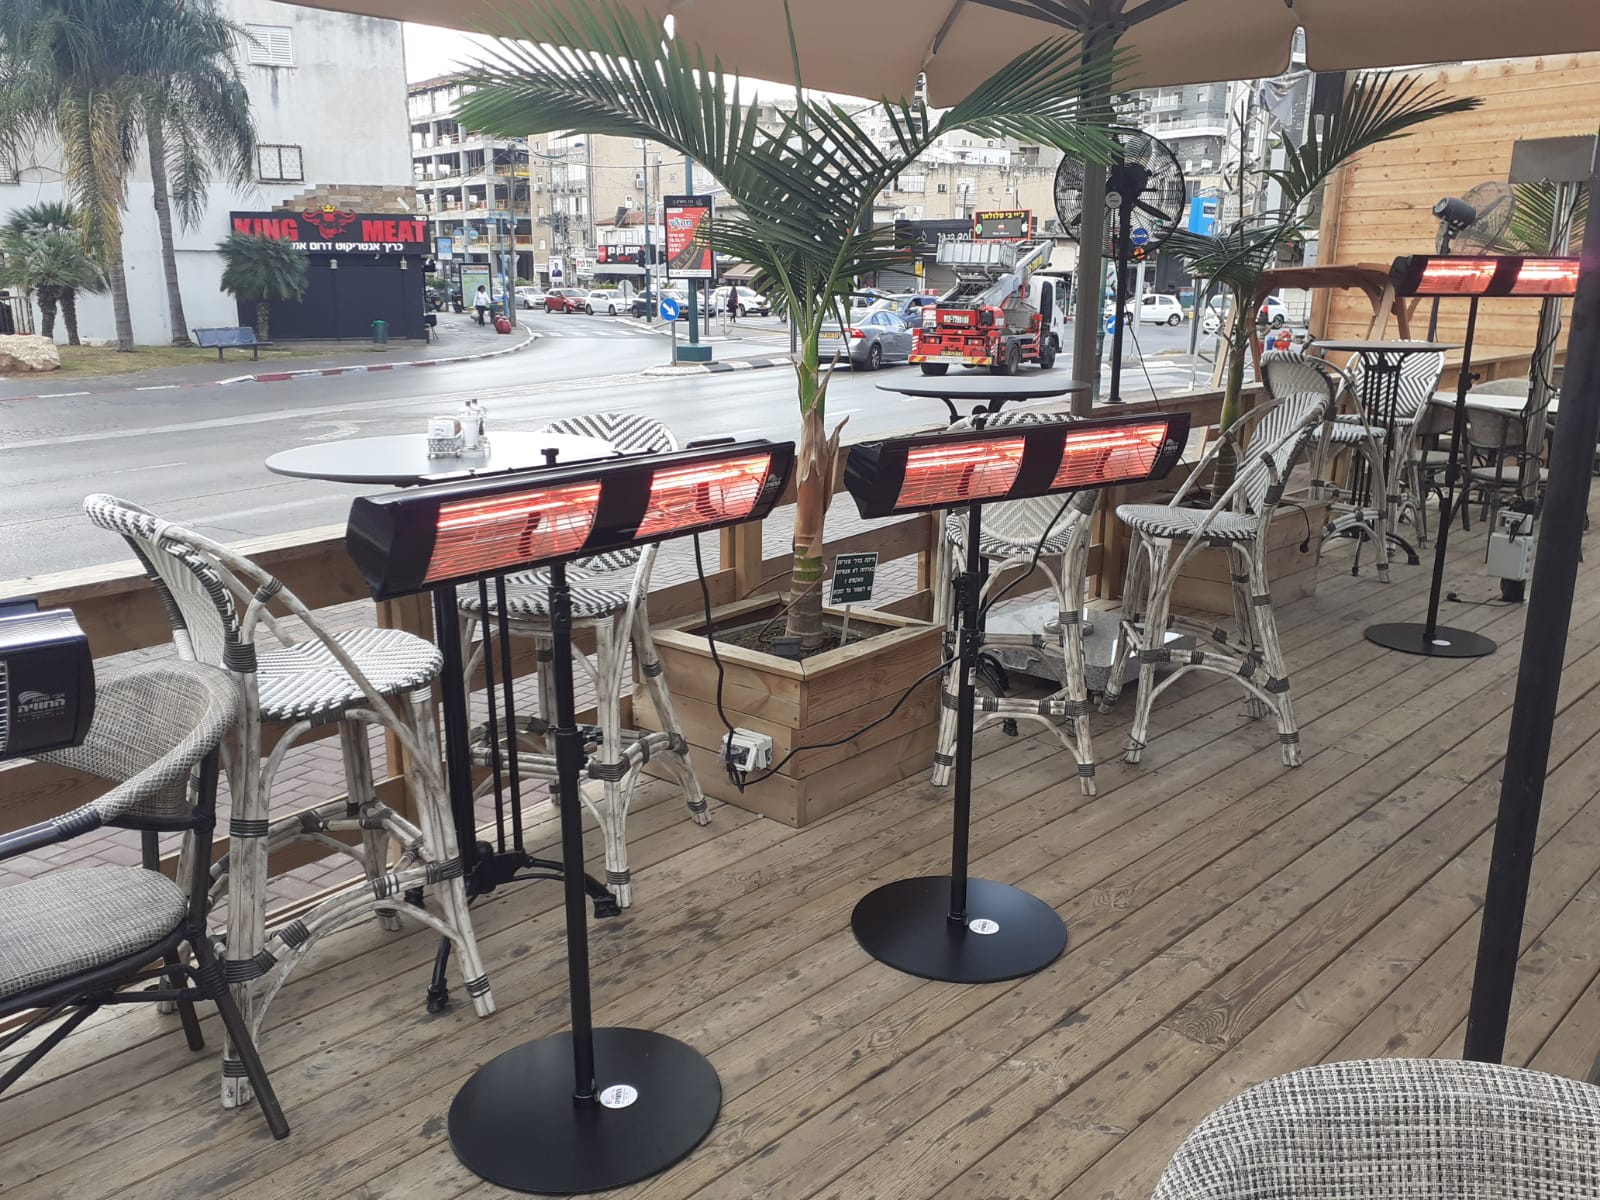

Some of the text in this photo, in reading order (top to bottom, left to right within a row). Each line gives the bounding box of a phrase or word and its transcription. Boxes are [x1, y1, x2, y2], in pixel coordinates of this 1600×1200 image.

[234, 217, 427, 243] KING MEAT
[309, 242, 332, 251] דרום
[335, 242, 381, 253] אנטריקוט
[382, 243, 404, 253] כריך
